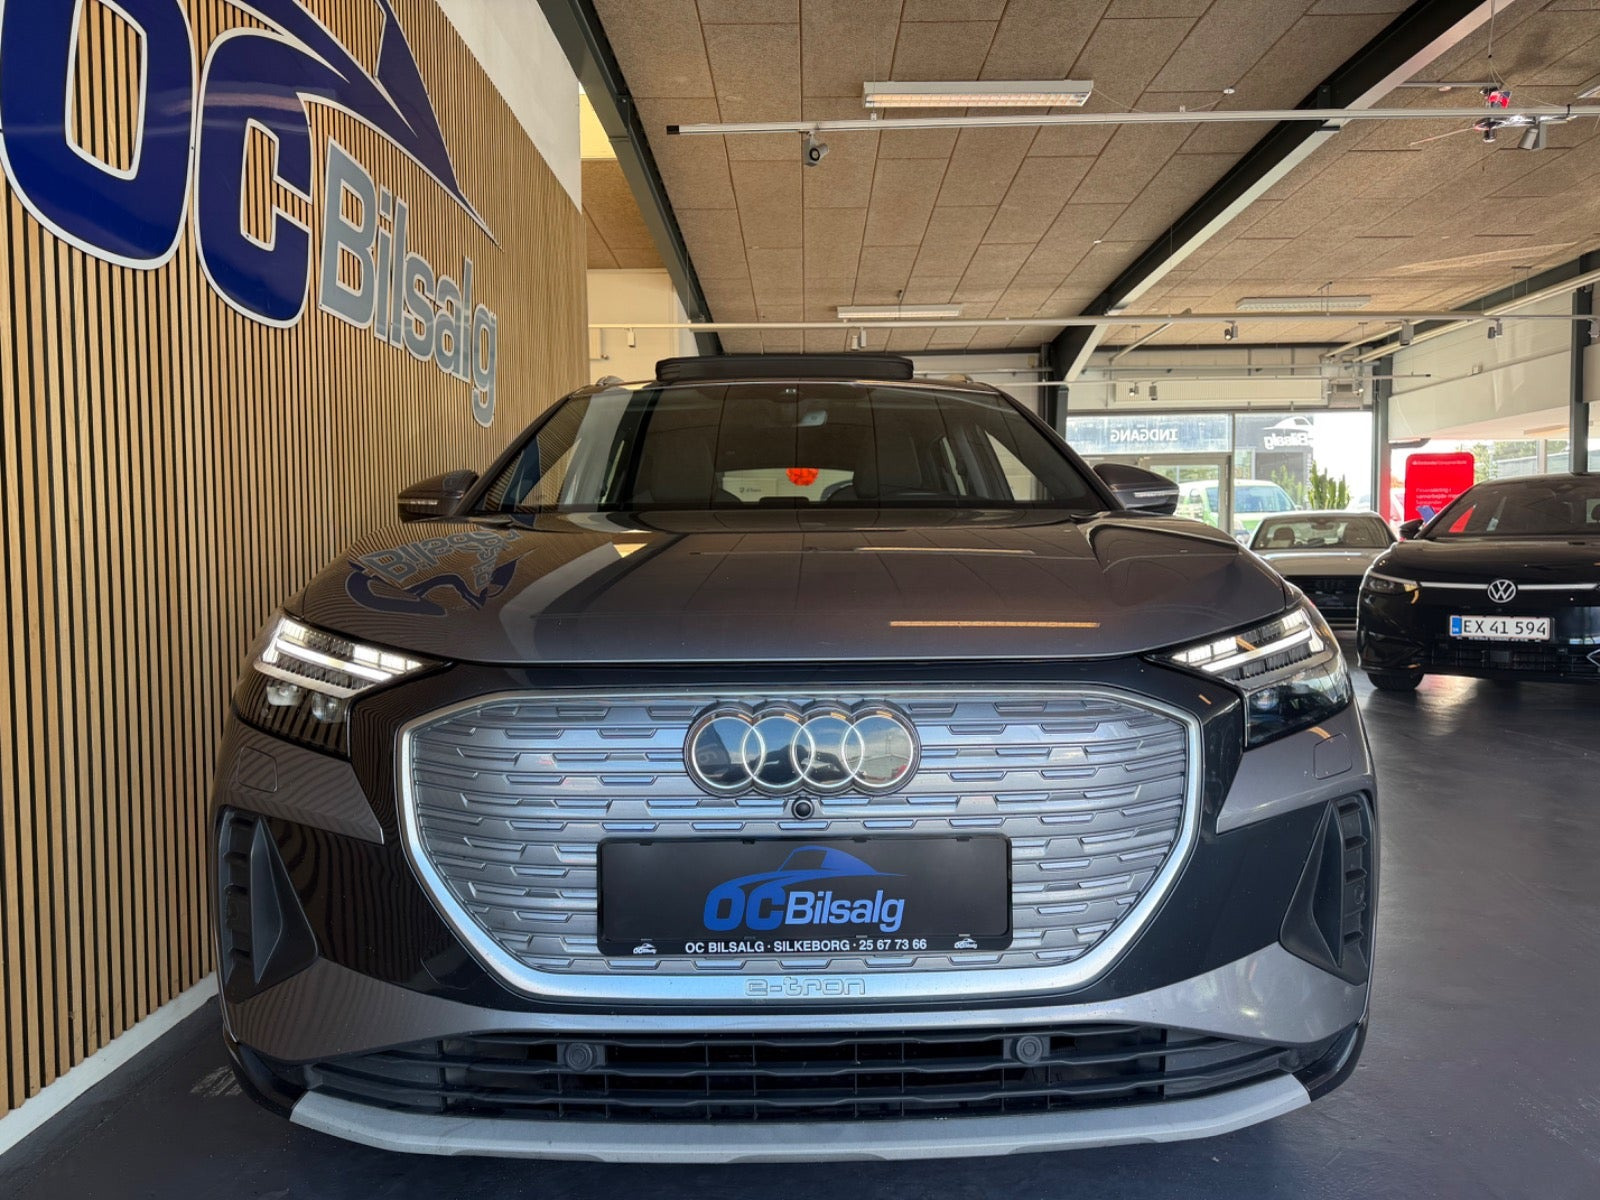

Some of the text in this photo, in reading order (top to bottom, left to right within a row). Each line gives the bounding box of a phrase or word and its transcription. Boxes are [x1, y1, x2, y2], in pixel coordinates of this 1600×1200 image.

[319, 136, 497, 428] Bilsalg
[1463, 620, 1484, 633] EX
[1489, 620, 1508, 634] 41
[1515, 621, 1546, 636] 594
[685, 937, 928, 953] OC BILSALG SILKEBORG 25 67 73 66
[744, 976, 866, 996] e-tron
